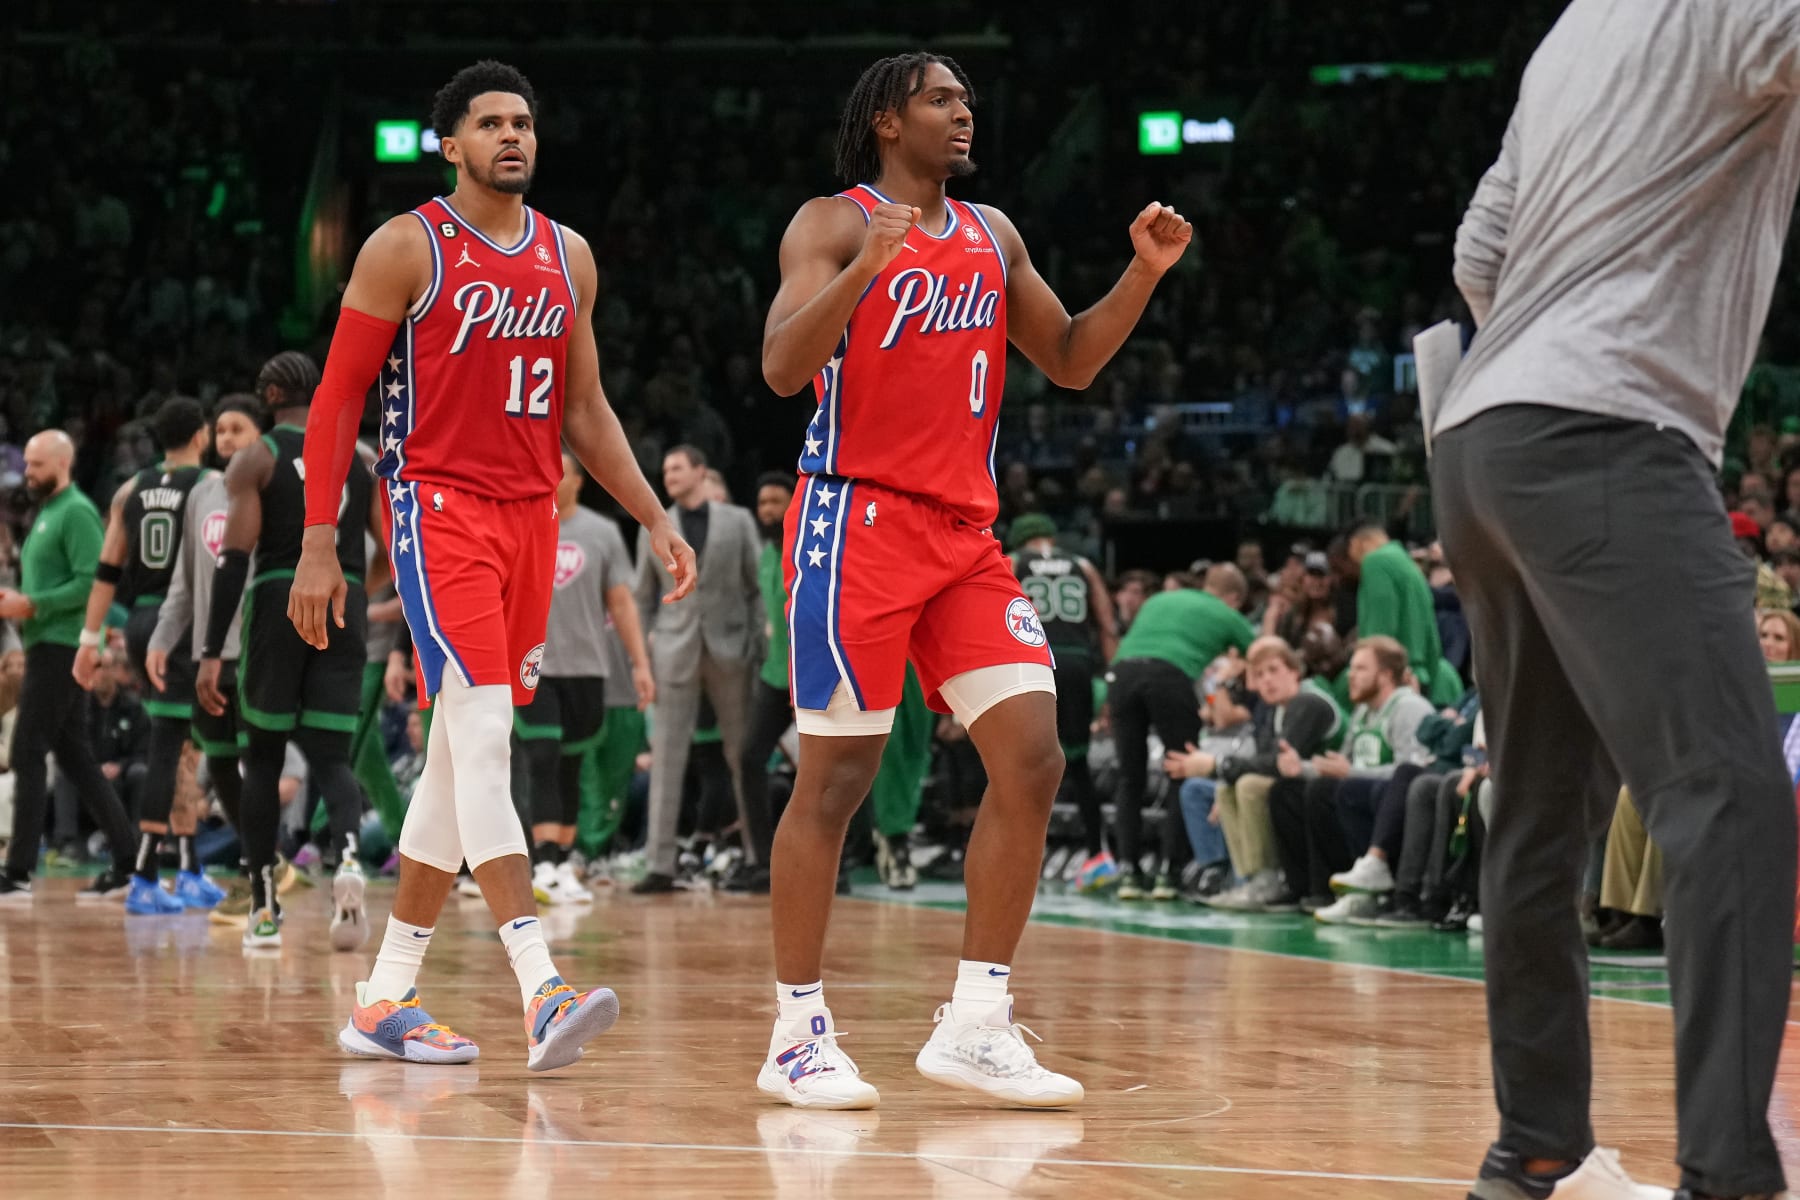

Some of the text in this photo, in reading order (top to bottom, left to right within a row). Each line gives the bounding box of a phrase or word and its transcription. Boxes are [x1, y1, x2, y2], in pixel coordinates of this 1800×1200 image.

[379, 126, 417, 155] TD
[1143, 118, 1178, 147] TD
[441, 223, 456, 238] 6
[449, 281, 567, 354] Phila
[880, 267, 999, 349] Phila
[505, 355, 554, 418] 12
[969, 349, 989, 418] 0
[140, 487, 183, 511] TATUM
[141, 512, 174, 569] 0
[1021, 575, 1087, 623] 36
[811, 1015, 826, 1035] 0
